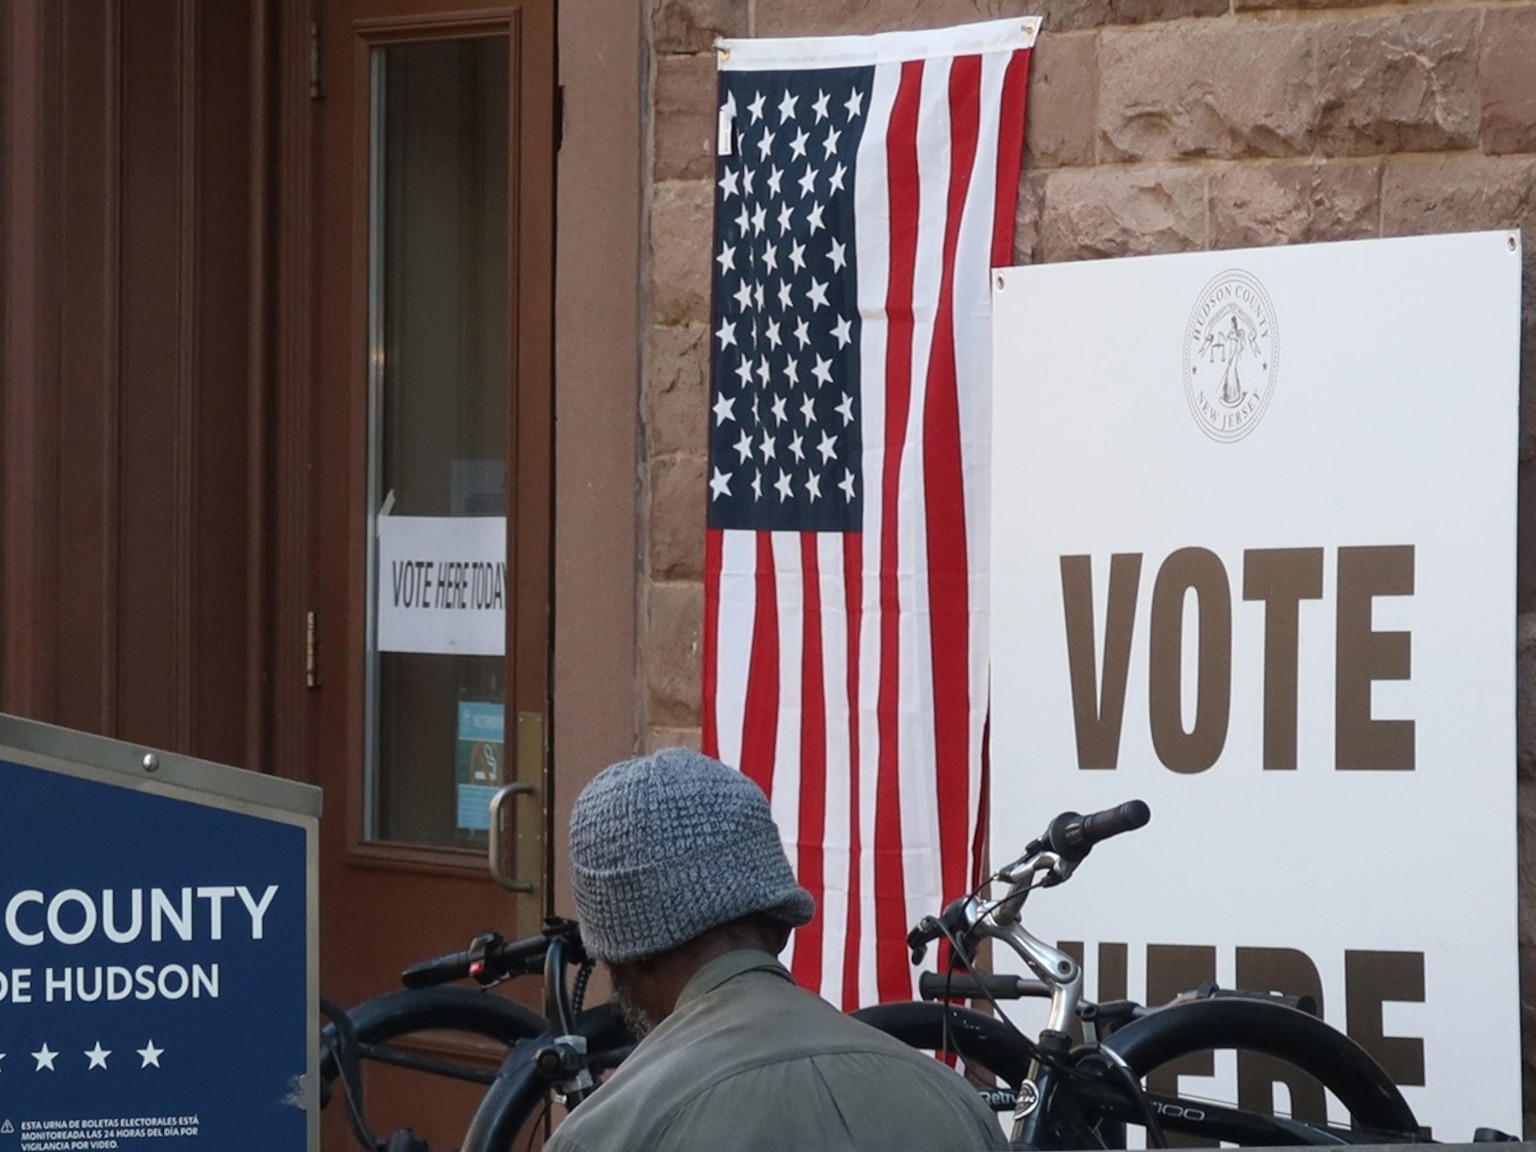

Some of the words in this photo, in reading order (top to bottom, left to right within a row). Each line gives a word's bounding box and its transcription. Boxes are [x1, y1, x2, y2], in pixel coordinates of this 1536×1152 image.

[1193, 284, 1233, 342] HUDSON
[1235, 285, 1270, 339] COUNTY
[1196, 390, 1218, 423] NEW
[1221, 388, 1261, 431] JERSEY
[392, 560, 434, 608] VOTE
[435, 561, 469, 610] HERE
[1059, 544, 1416, 774] VOTE
[6, 885, 278, 945] COUNTY
[46, 964, 218, 1001] HUDSON
